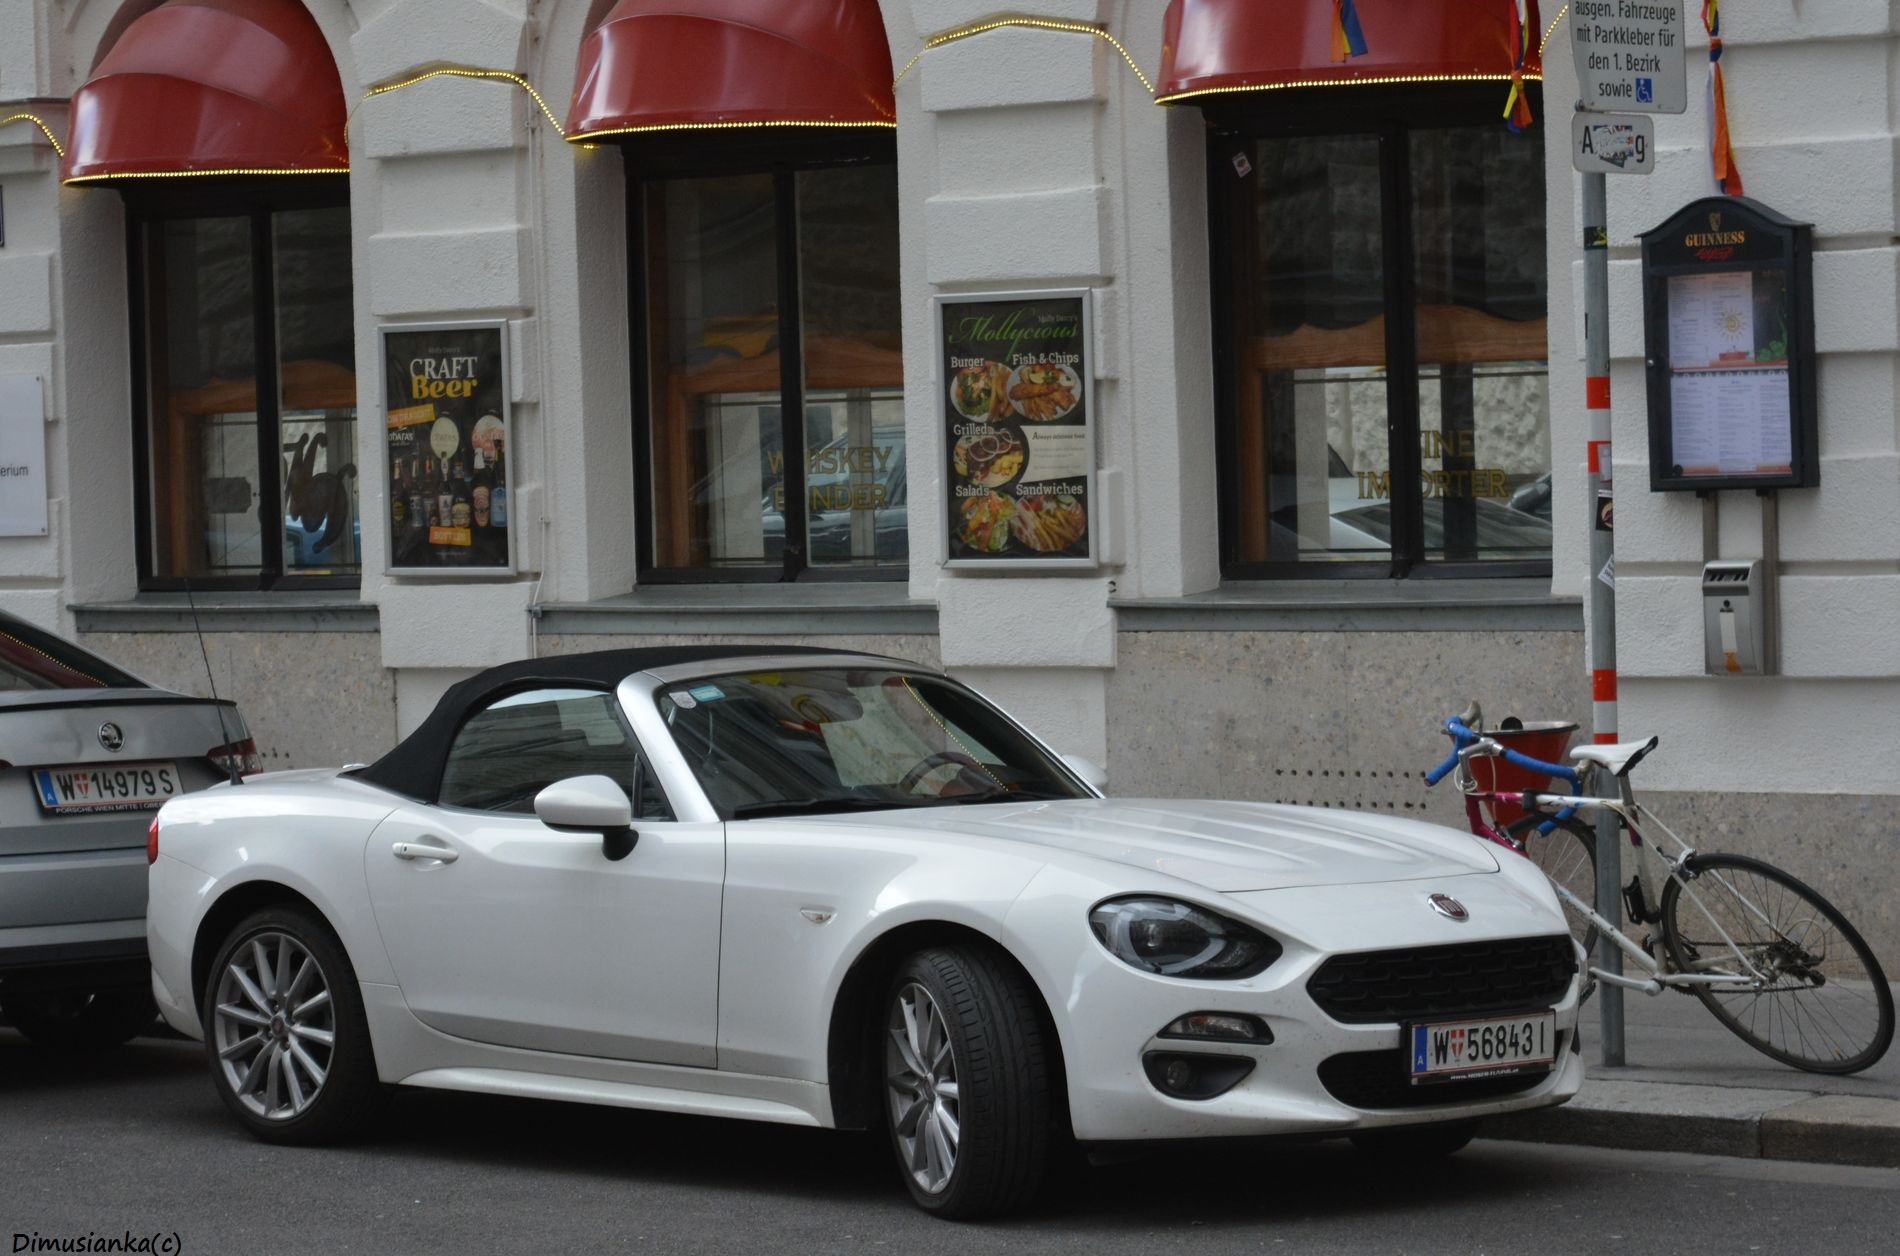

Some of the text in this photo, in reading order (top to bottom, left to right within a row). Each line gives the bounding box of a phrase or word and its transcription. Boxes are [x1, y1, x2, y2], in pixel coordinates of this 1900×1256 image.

[1575, 1, 1676, 24] ausgen. Fahrzeuge
[1577, 24, 1675, 47] mit Parkkleber für
[1588, 52, 1661, 73] den 1. Bezirk
[1599, 79, 1632, 98] sowie
[1685, 230, 1745, 247] GUINNESS
[410, 357, 478, 379] CRAFT
[951, 356, 984, 369] Burger
[1012, 352, 1079, 366] Fish & Chips
[412, 374, 478, 399] Beer
[953, 422, 987, 436] Grilled
[1421, 430, 1474, 459] INE
[955, 485, 990, 497] Salads
[1016, 482, 1083, 496] Sandwiches
[1357, 469, 1509, 499] IMORTER
[56, 774, 75, 800] W
[91, 770, 156, 798] 14979
[159, 769, 174, 794] S
[1434, 1031, 1449, 1065] W
